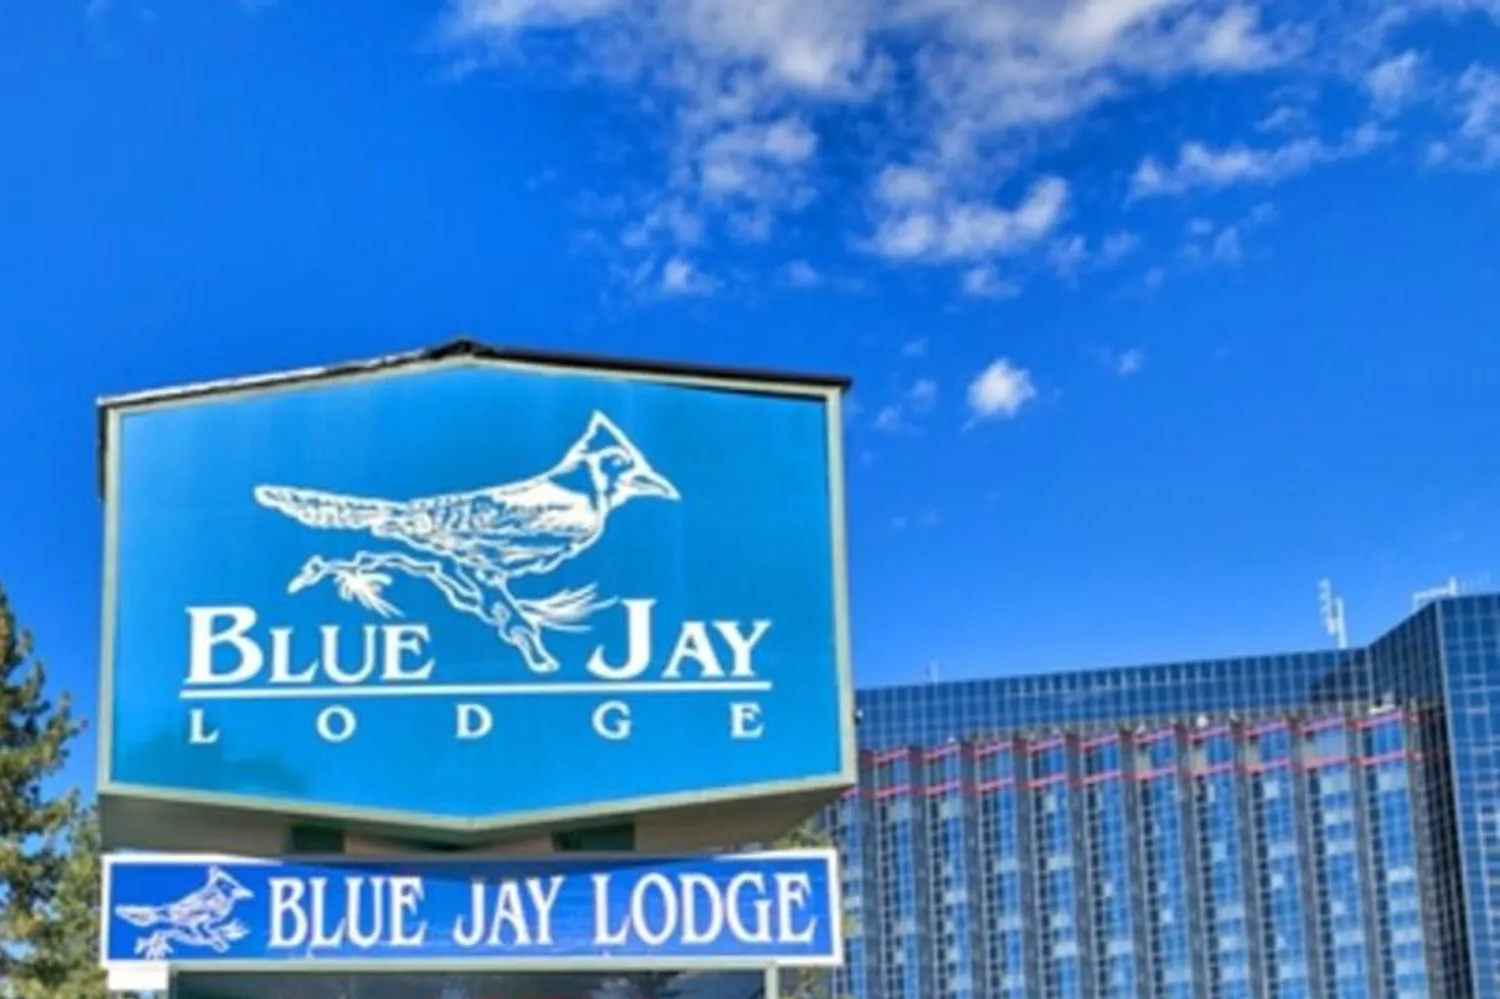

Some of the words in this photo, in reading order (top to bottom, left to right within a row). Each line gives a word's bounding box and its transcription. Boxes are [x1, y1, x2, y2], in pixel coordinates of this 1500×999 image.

[184, 605, 435, 684] BLUE
[587, 599, 772, 679] JAY
[189, 701, 763, 743] LODGE
[267, 876, 426, 947] BLUE
[454, 876, 563, 945] JAY
[591, 873, 815, 944] LODGE
